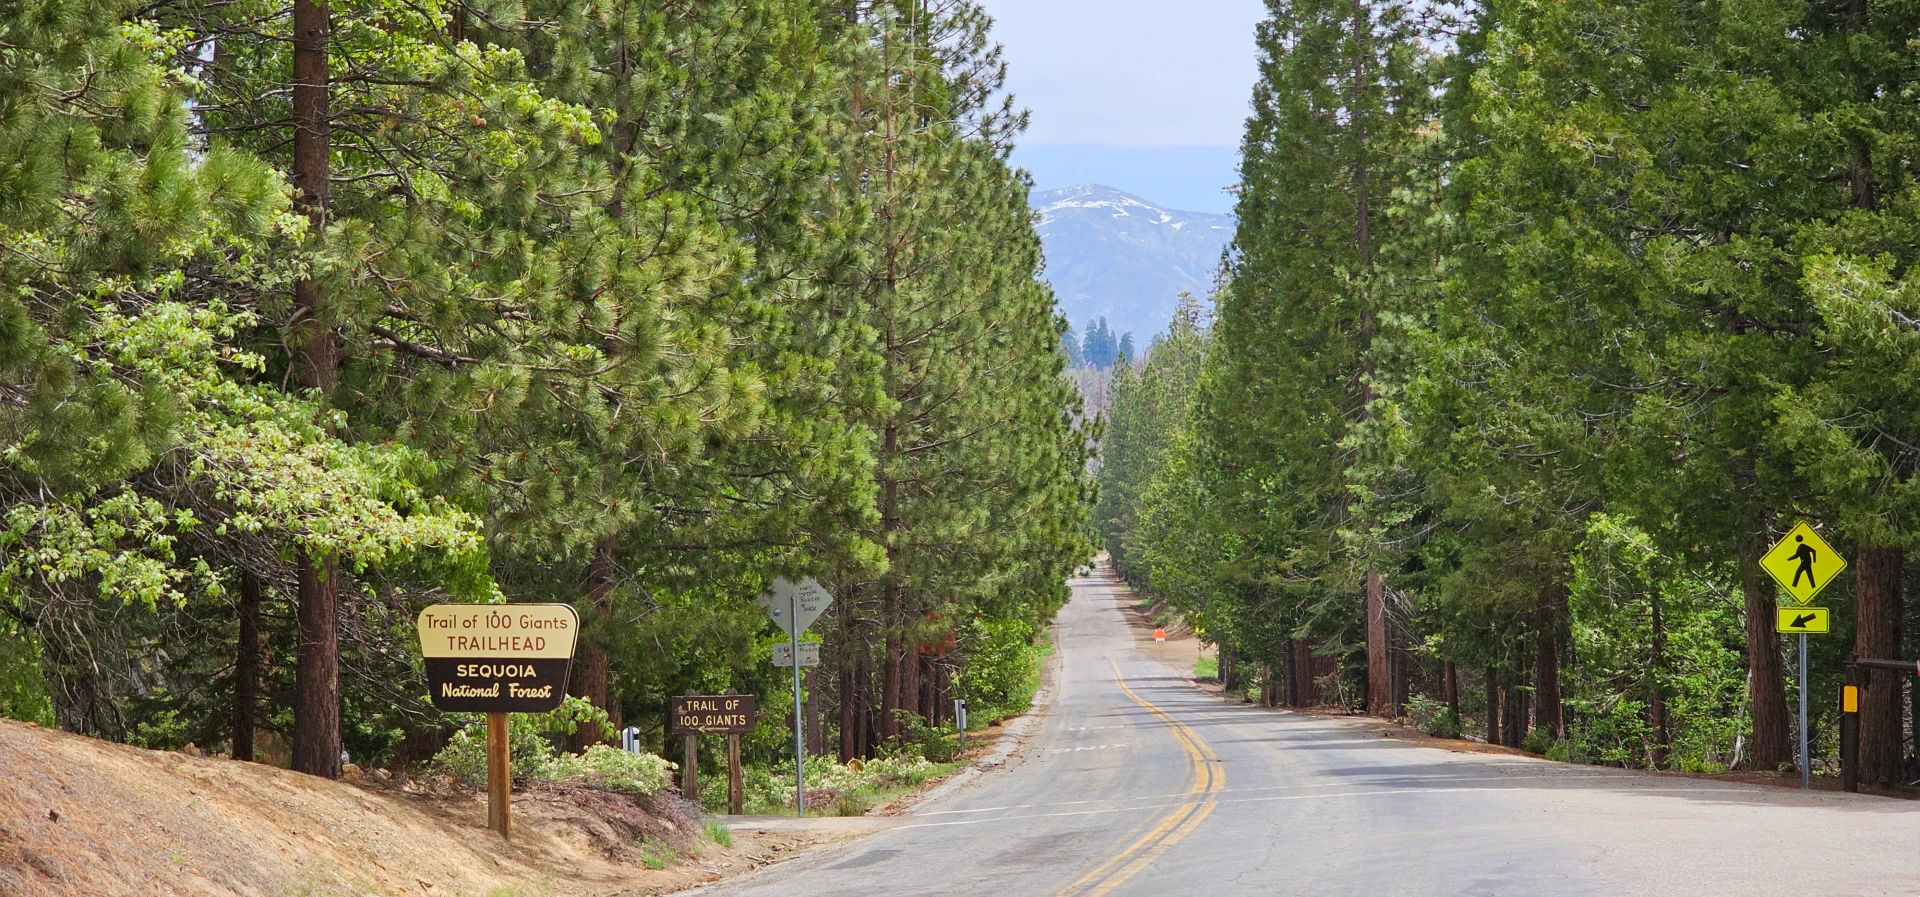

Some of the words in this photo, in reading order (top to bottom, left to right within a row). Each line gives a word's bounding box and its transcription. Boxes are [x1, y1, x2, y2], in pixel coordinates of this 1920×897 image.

[426, 614, 457, 629] Trail
[462, 614, 478, 629] of
[486, 614, 512, 629] 100
[520, 614, 568, 630] Giants
[447, 636, 546, 651] TRAILHEAD
[456, 664, 537, 678] SEQUOIA
[442, 682, 500, 698] National
[508, 683, 553, 699] Forest
[686, 700, 719, 712] TRAIL
[725, 699, 740, 711] OF
[680, 715, 699, 727] 100
[705, 714, 746, 726] GIANTS
